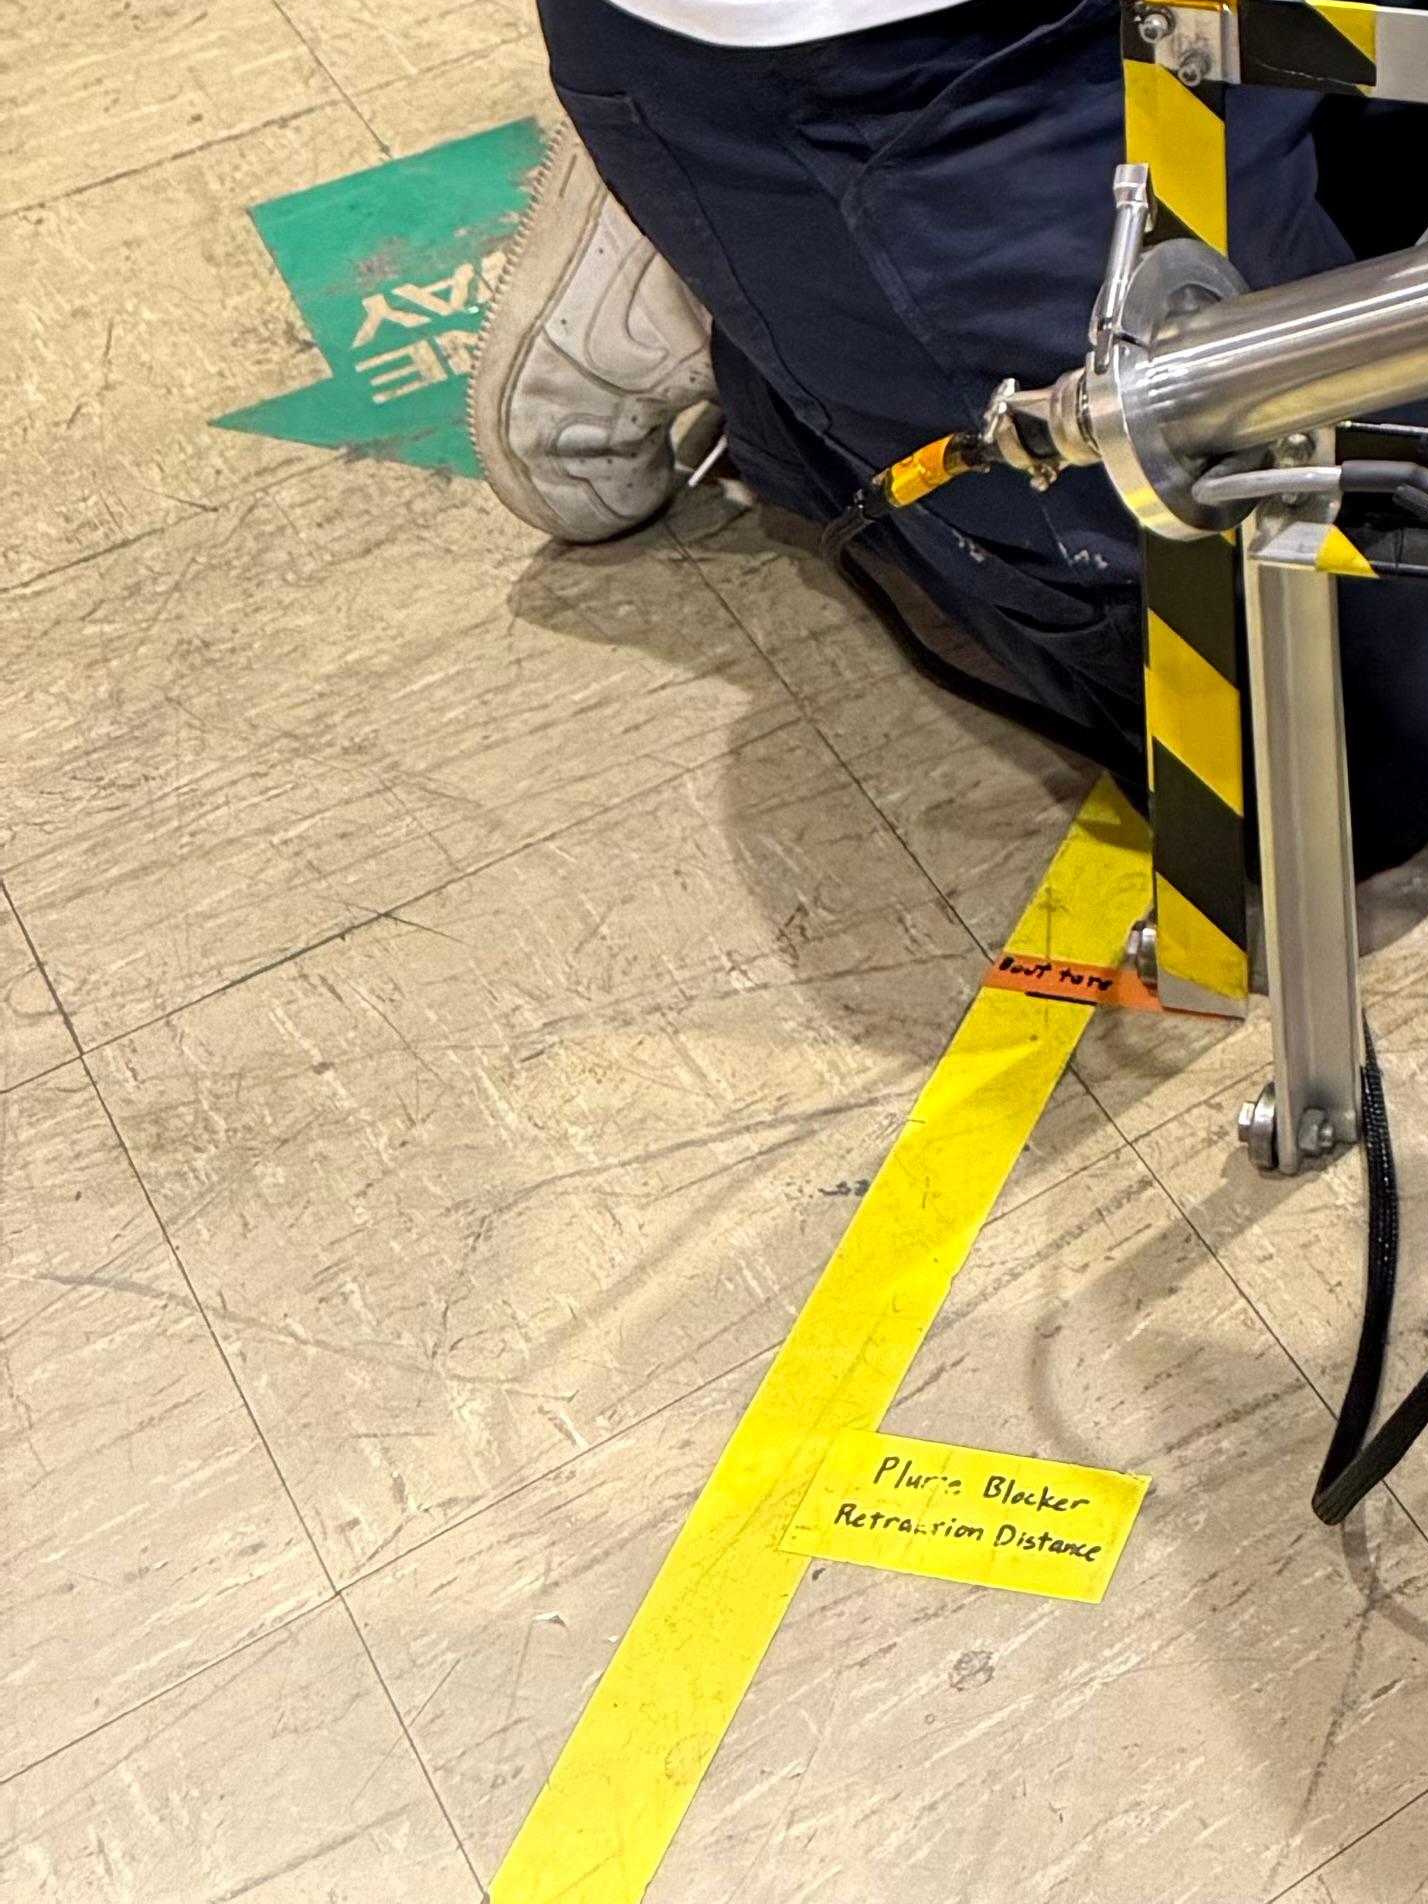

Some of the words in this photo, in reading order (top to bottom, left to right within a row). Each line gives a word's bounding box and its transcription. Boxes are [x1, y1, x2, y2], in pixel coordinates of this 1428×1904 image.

[354, 329, 482, 405] NE
[981, 1474, 1091, 1514] Blocker
[833, 1502, 984, 1543] Retraction
[992, 1523, 1102, 1563] Distance
